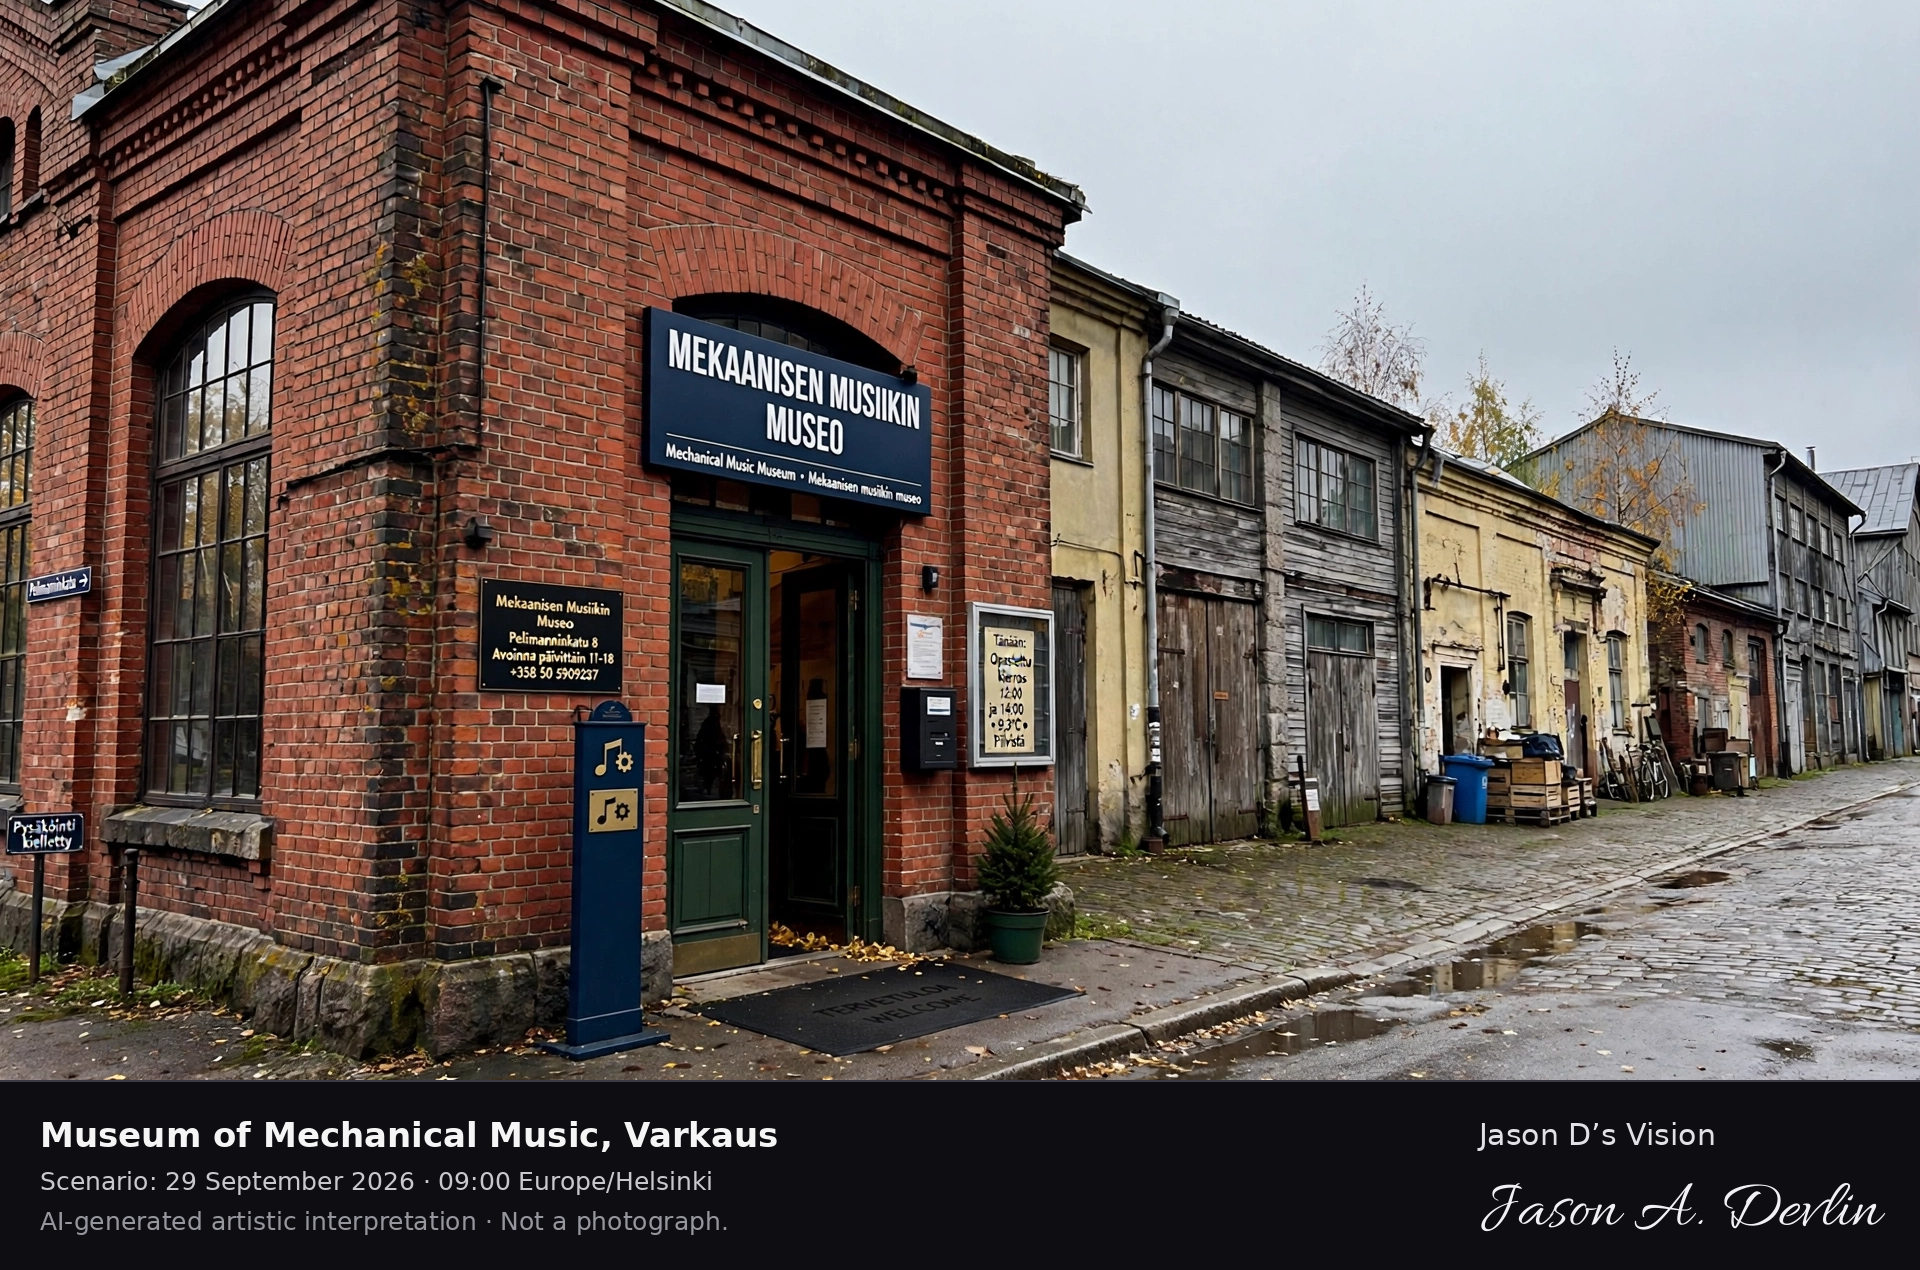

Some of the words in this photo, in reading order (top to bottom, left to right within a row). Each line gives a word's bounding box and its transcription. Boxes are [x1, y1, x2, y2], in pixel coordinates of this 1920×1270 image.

[669, 328, 824, 405] MEKAANISEN
[829, 373, 920, 430] MUSIIKIN
[766, 402, 844, 456] MUSEO
[665, 442, 724, 468] Mechanical
[726, 456, 755, 474] Music
[757, 460, 796, 482] Museum
[808, 471, 859, 494] Mekaanisen
[896, 491, 922, 505] museo
[495, 594, 563, 613] Mekaanisen
[566, 600, 611, 617] Musiikin
[536, 614, 575, 630] Museo
[509, 631, 590, 649] Pelimanninkatu
[591, 636, 599, 649] 8
[491, 647, 537, 662] Avoinna
[589, 652, 615, 665] 11-18
[510, 665, 537, 679] +358
[539, 666, 553, 679] 50
[555, 667, 600, 682] 5909237
[812, 983, 958, 1018] TERVETULOA
[862, 993, 983, 1024] WELCOME
